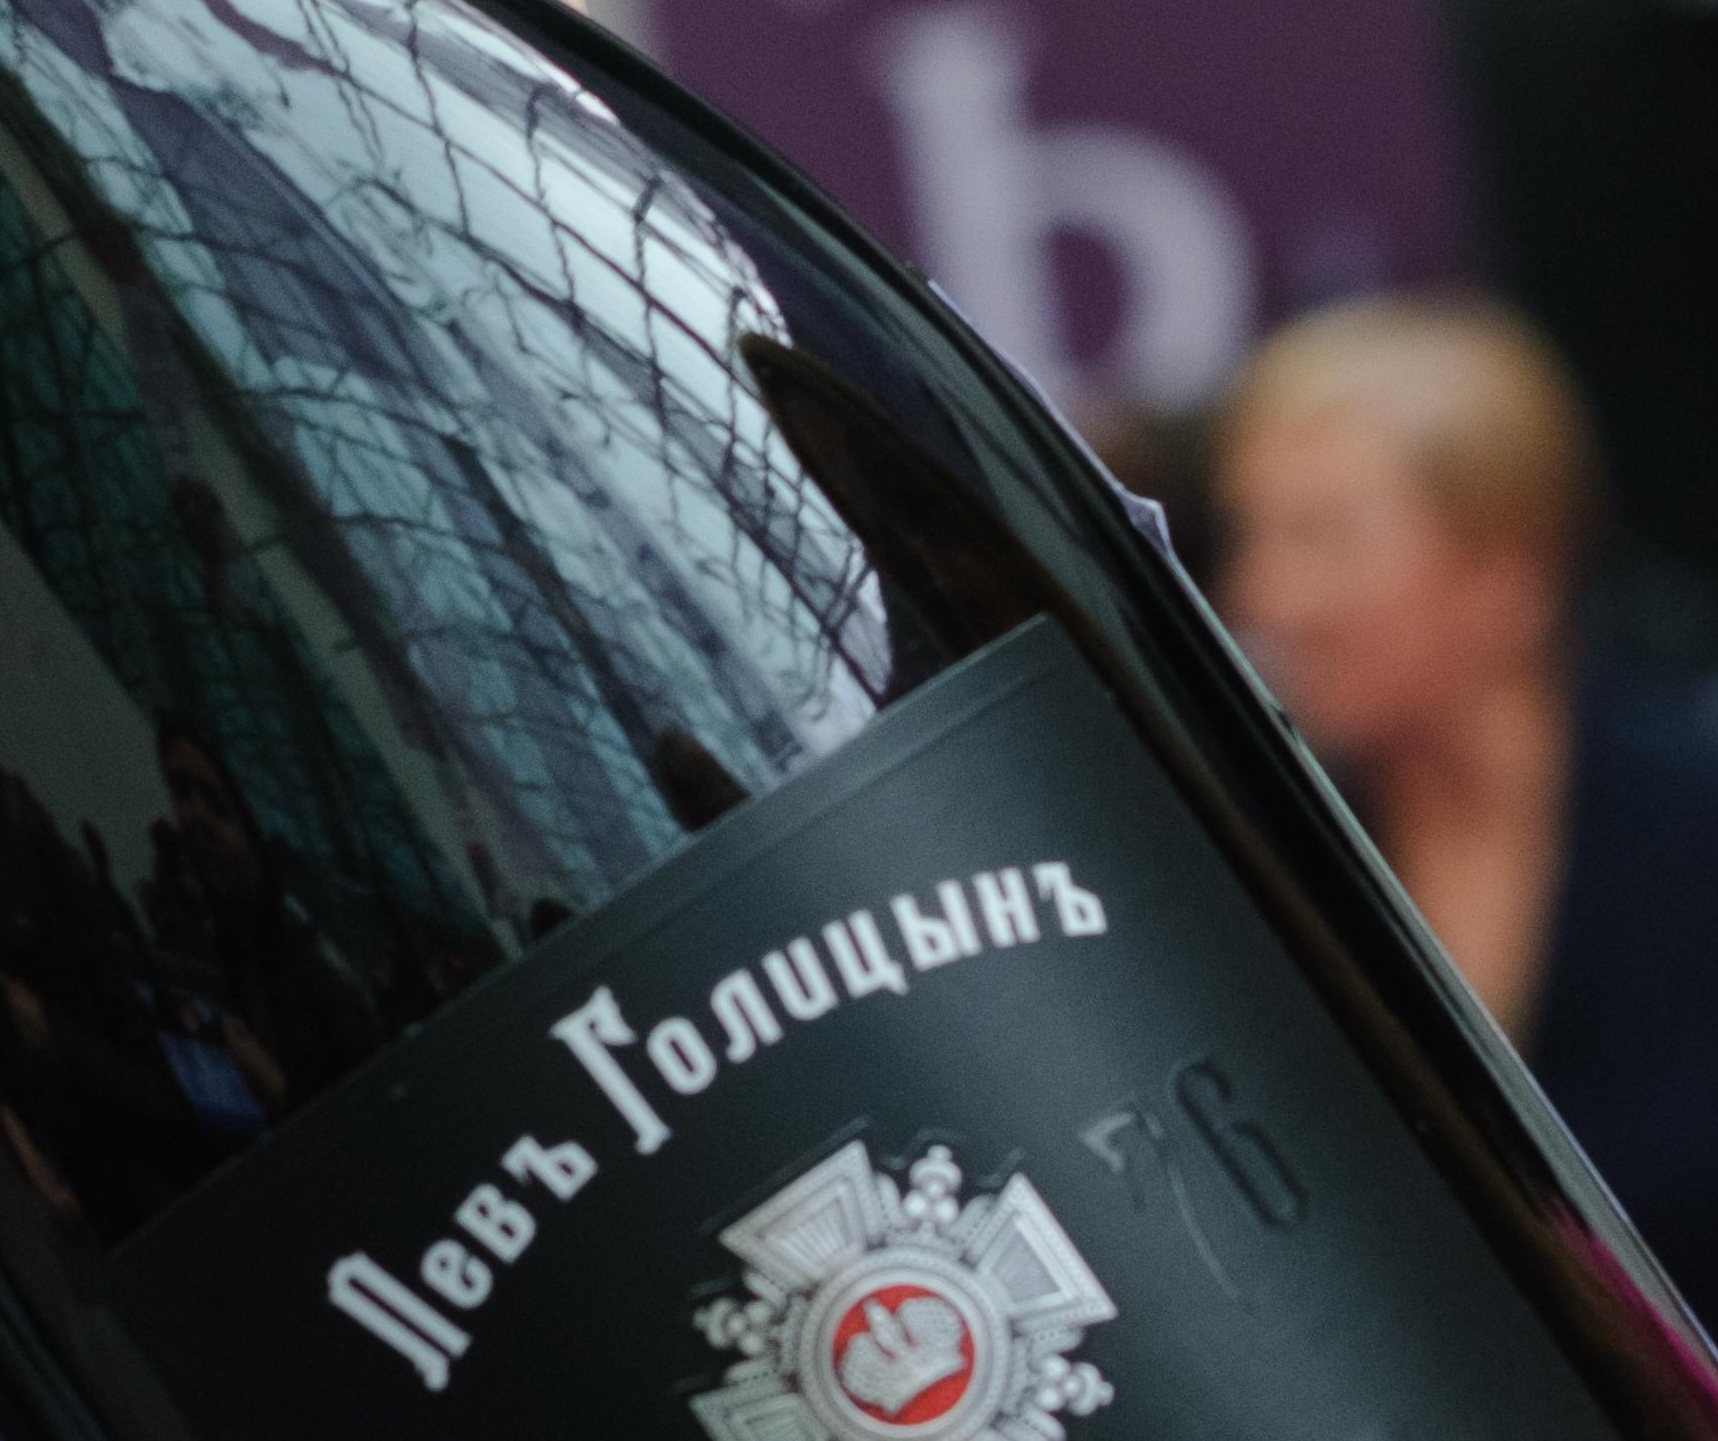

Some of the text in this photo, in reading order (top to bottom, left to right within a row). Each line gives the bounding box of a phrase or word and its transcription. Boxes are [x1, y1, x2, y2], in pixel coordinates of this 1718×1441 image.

[327, 860, 1107, 1392] Левъ Голицынъ
[1078, 1050, 1310, 1303] 76
